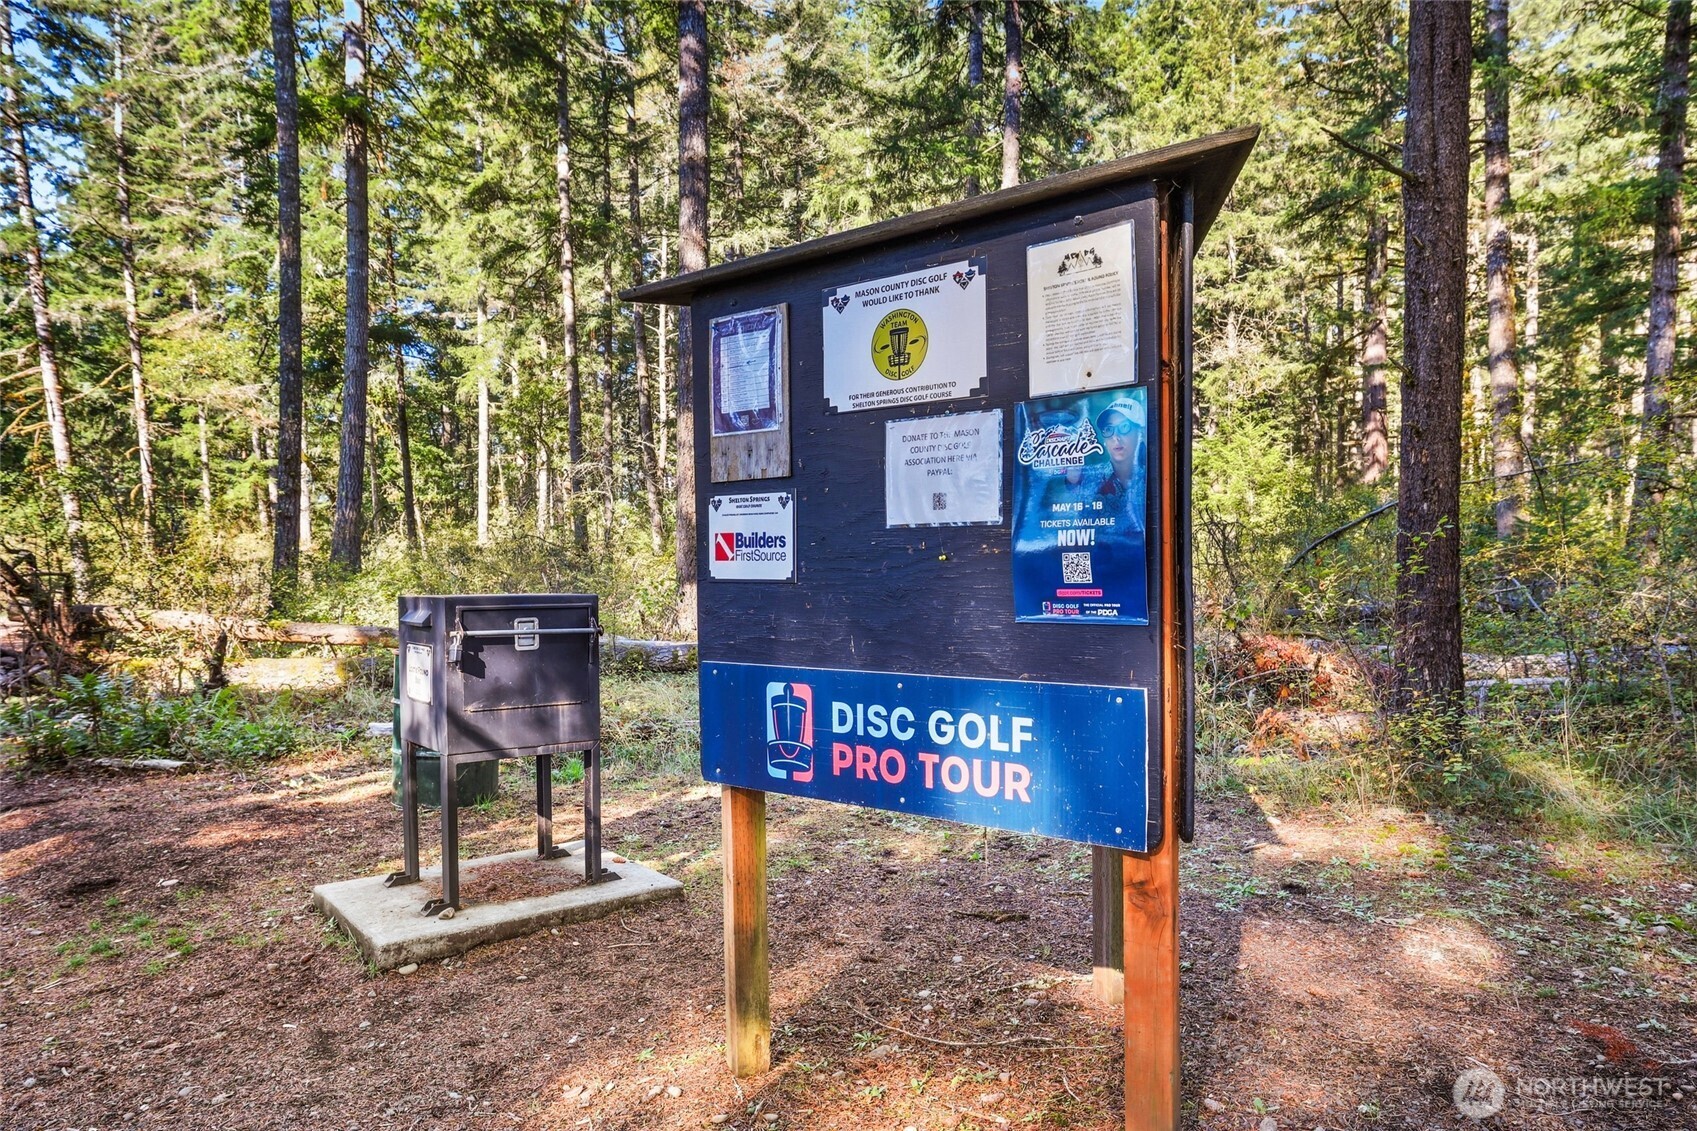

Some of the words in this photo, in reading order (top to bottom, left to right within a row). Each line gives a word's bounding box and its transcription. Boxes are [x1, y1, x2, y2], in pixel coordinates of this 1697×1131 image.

[855, 287, 879, 298] MASON
[881, 280, 909, 293] COUNTY
[911, 276, 927, 287] DISC
[929, 272, 948, 283] GOLF
[862, 296, 887, 307] WOULD
[889, 292, 903, 302] LIKE
[904, 291, 914, 300] TO
[915, 286, 940, 297] THANK
[880, 311, 919, 329] WASHINGTON
[891, 320, 907, 328] TEAM
[885, 368, 898, 378] DISC
[901, 365, 915, 377] GOLF
[849, 393, 860, 401] FOR
[876, 388, 904, 397] GENEROUS
[905, 382, 948, 394] CONTRIBUTION
[852, 400, 876, 408] SHELTON
[876, 397, 899, 406] SPRINGS
[914, 393, 928, 401] GOLF
[930, 391, 952, 399] COURSE
[902, 433, 927, 442] DONATE
[930, 432, 938, 440] TO
[954, 428, 980, 437] MASON
[910, 444, 936, 454] COUNTY
[938, 443, 952, 452] DSC
[1020, 428, 1102, 463] Cascade
[905, 456, 946, 466] ASSOCIATION
[947, 454, 964, 462] HERE
[1034, 456, 1083, 468] CHALLENGE
[1052, 504, 1070, 512] MAY
[1040, 520, 1071, 528] TICKETS
[1072, 518, 1115, 527] AVAILABLE
[735, 532, 786, 548] Builders
[1058, 529, 1095, 546] NOW!
[735, 549, 786, 562] FirstSource
[832, 701, 915, 741] DISC
[928, 710, 1033, 753] GOLF
[832, 742, 906, 784] PRO
[918, 752, 1031, 803] TOUR
